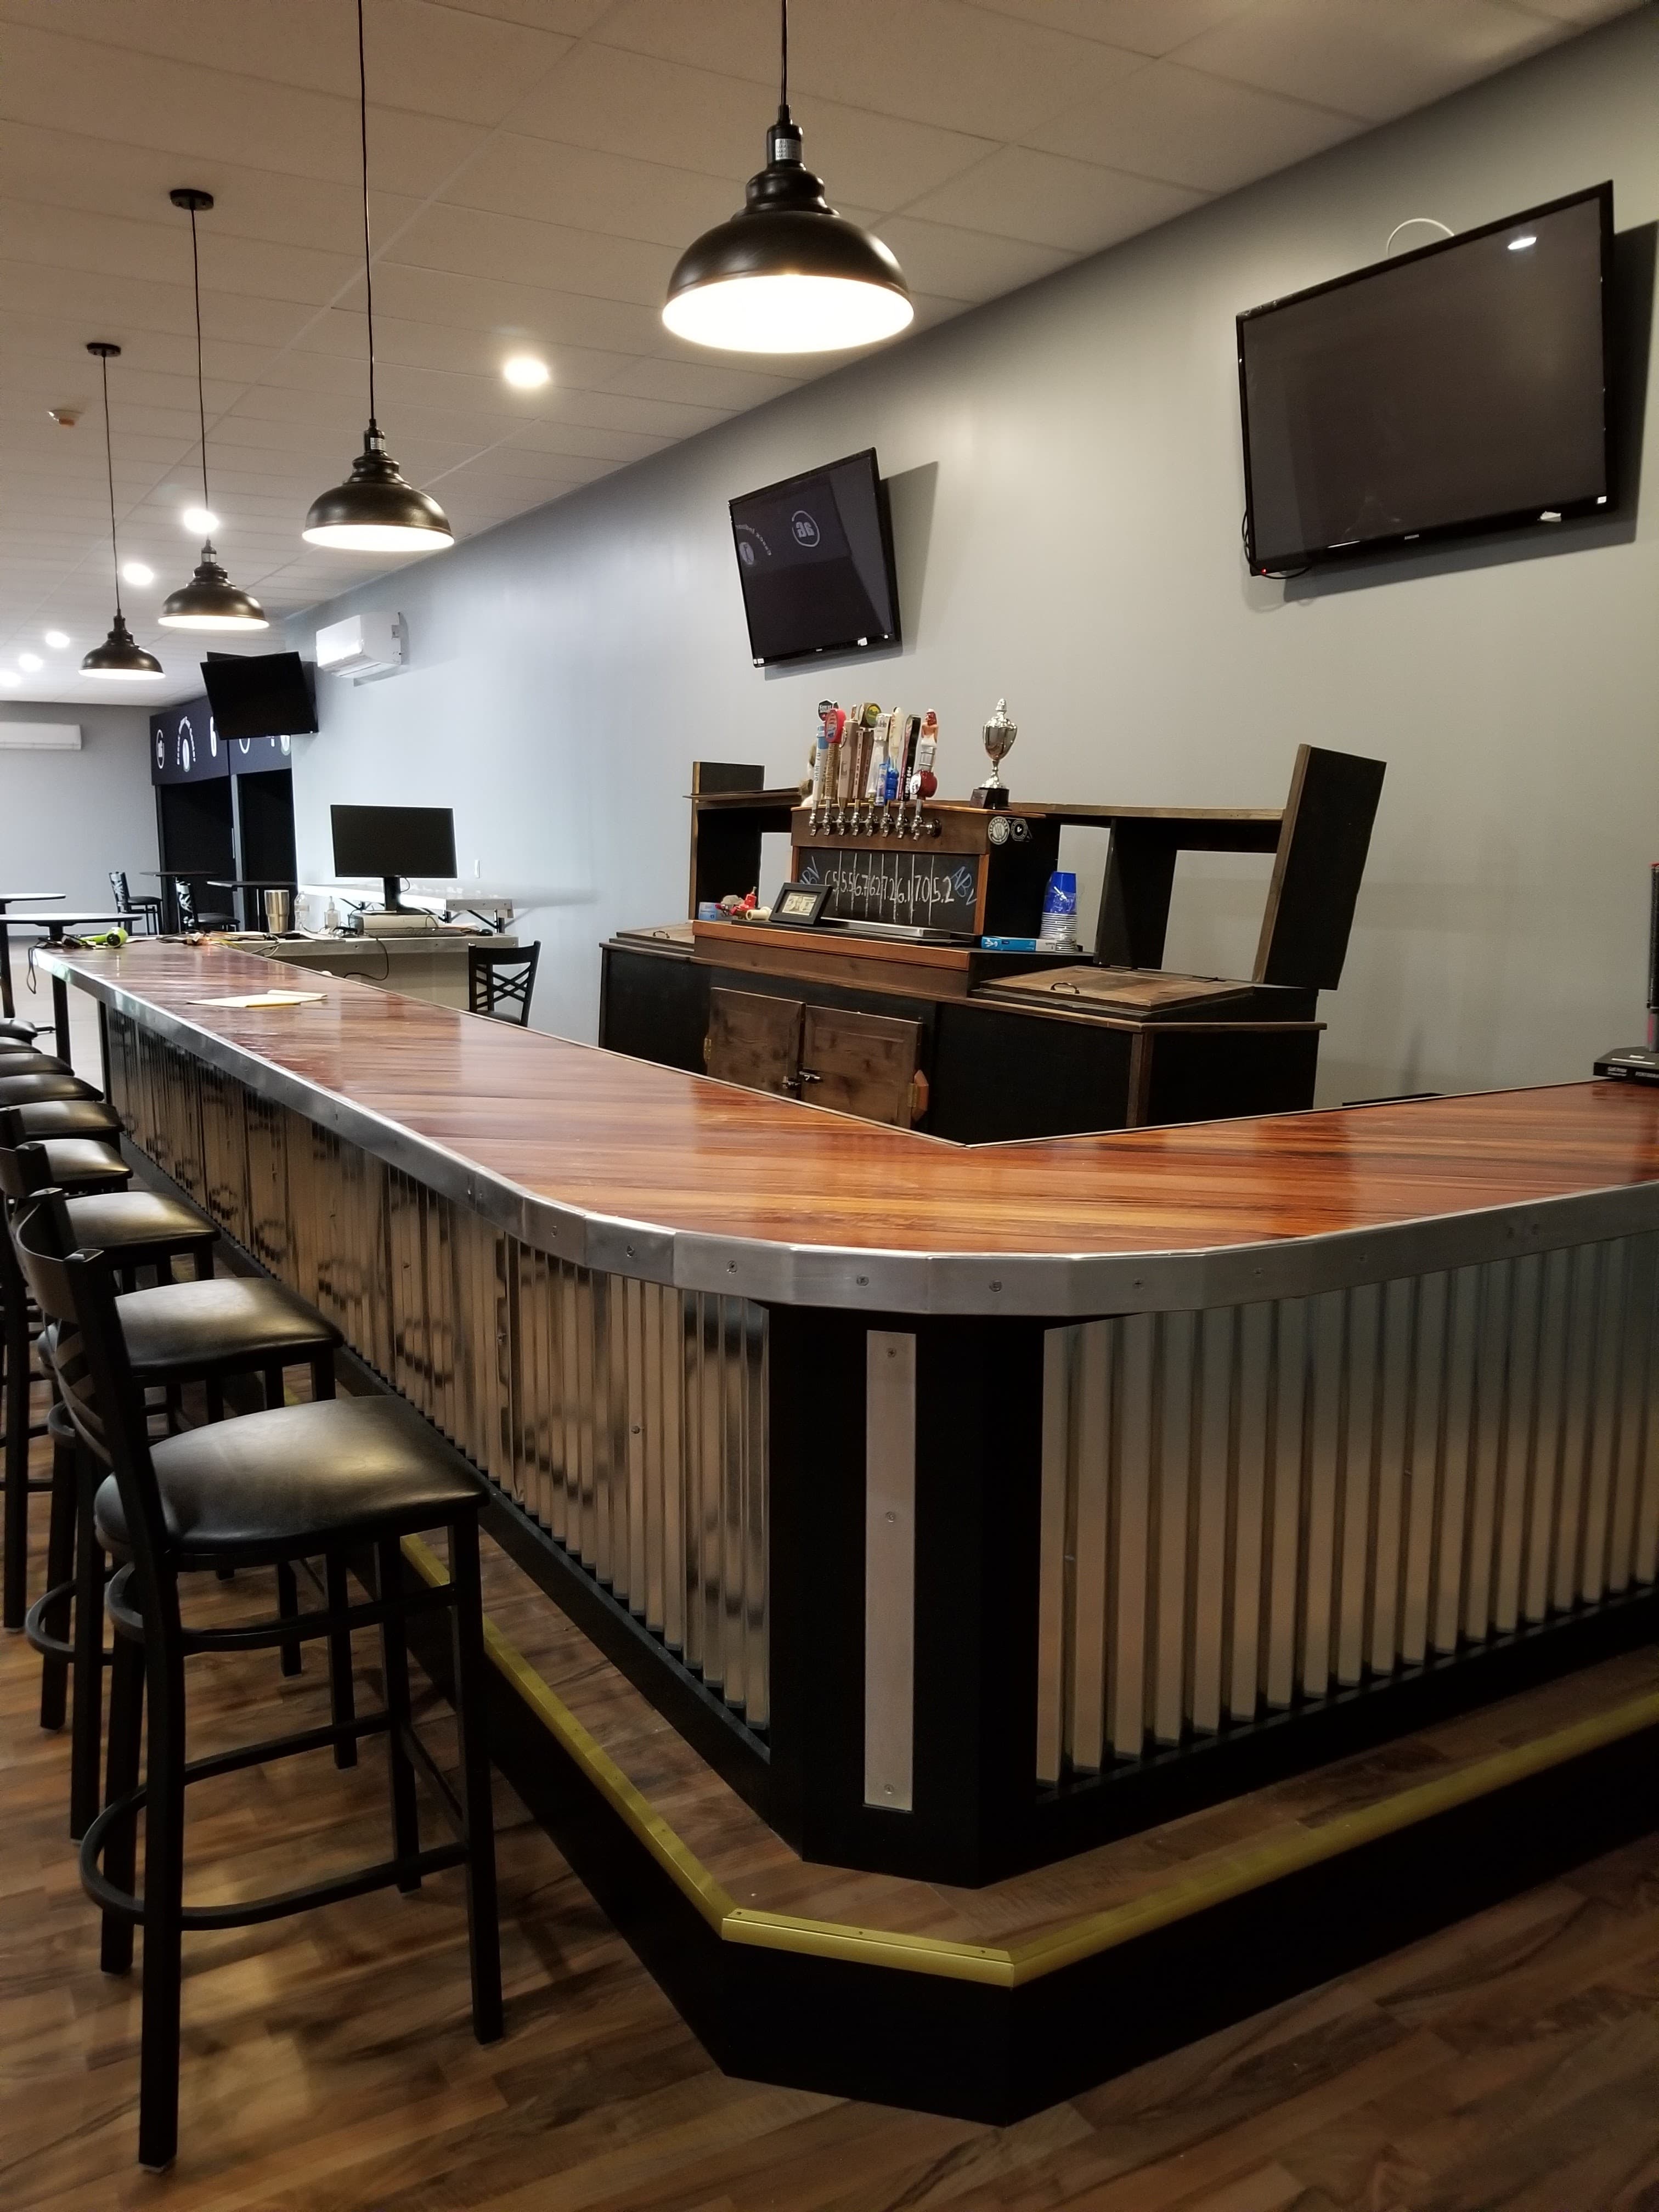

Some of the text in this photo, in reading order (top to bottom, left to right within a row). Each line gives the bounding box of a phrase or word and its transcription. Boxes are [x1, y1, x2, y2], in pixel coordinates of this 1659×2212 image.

[800, 855, 820, 884] BV
[854, 873, 868, 896] 6.7
[882, 876, 896, 901] 7.2
[897, 878, 911, 904] 6.1
[915, 875, 930, 903] 7.0
[931, 876, 955, 904] 5.2
